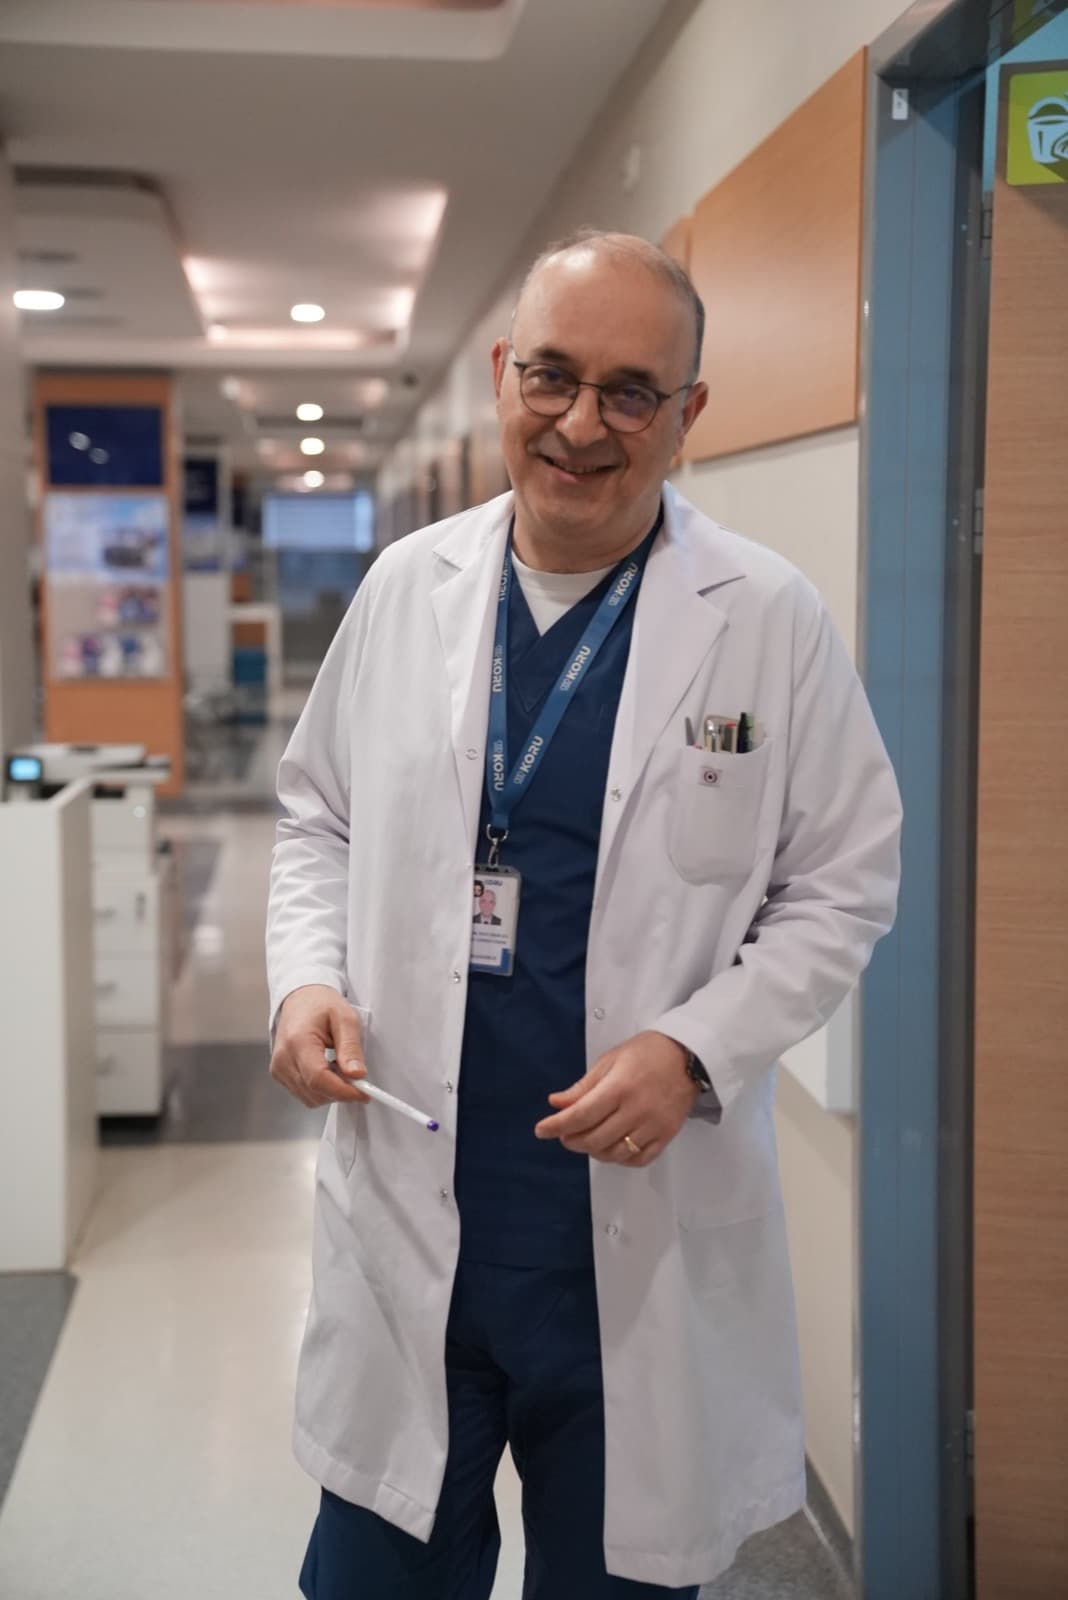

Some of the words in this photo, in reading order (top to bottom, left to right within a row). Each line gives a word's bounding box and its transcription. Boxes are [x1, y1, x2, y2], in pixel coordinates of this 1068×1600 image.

[614, 562, 639, 596] KORU
[492, 657, 502, 692] KORU
[566, 645, 591, 681] KORU
[493, 753, 504, 791] KORU
[519, 735, 543, 773] KORU
